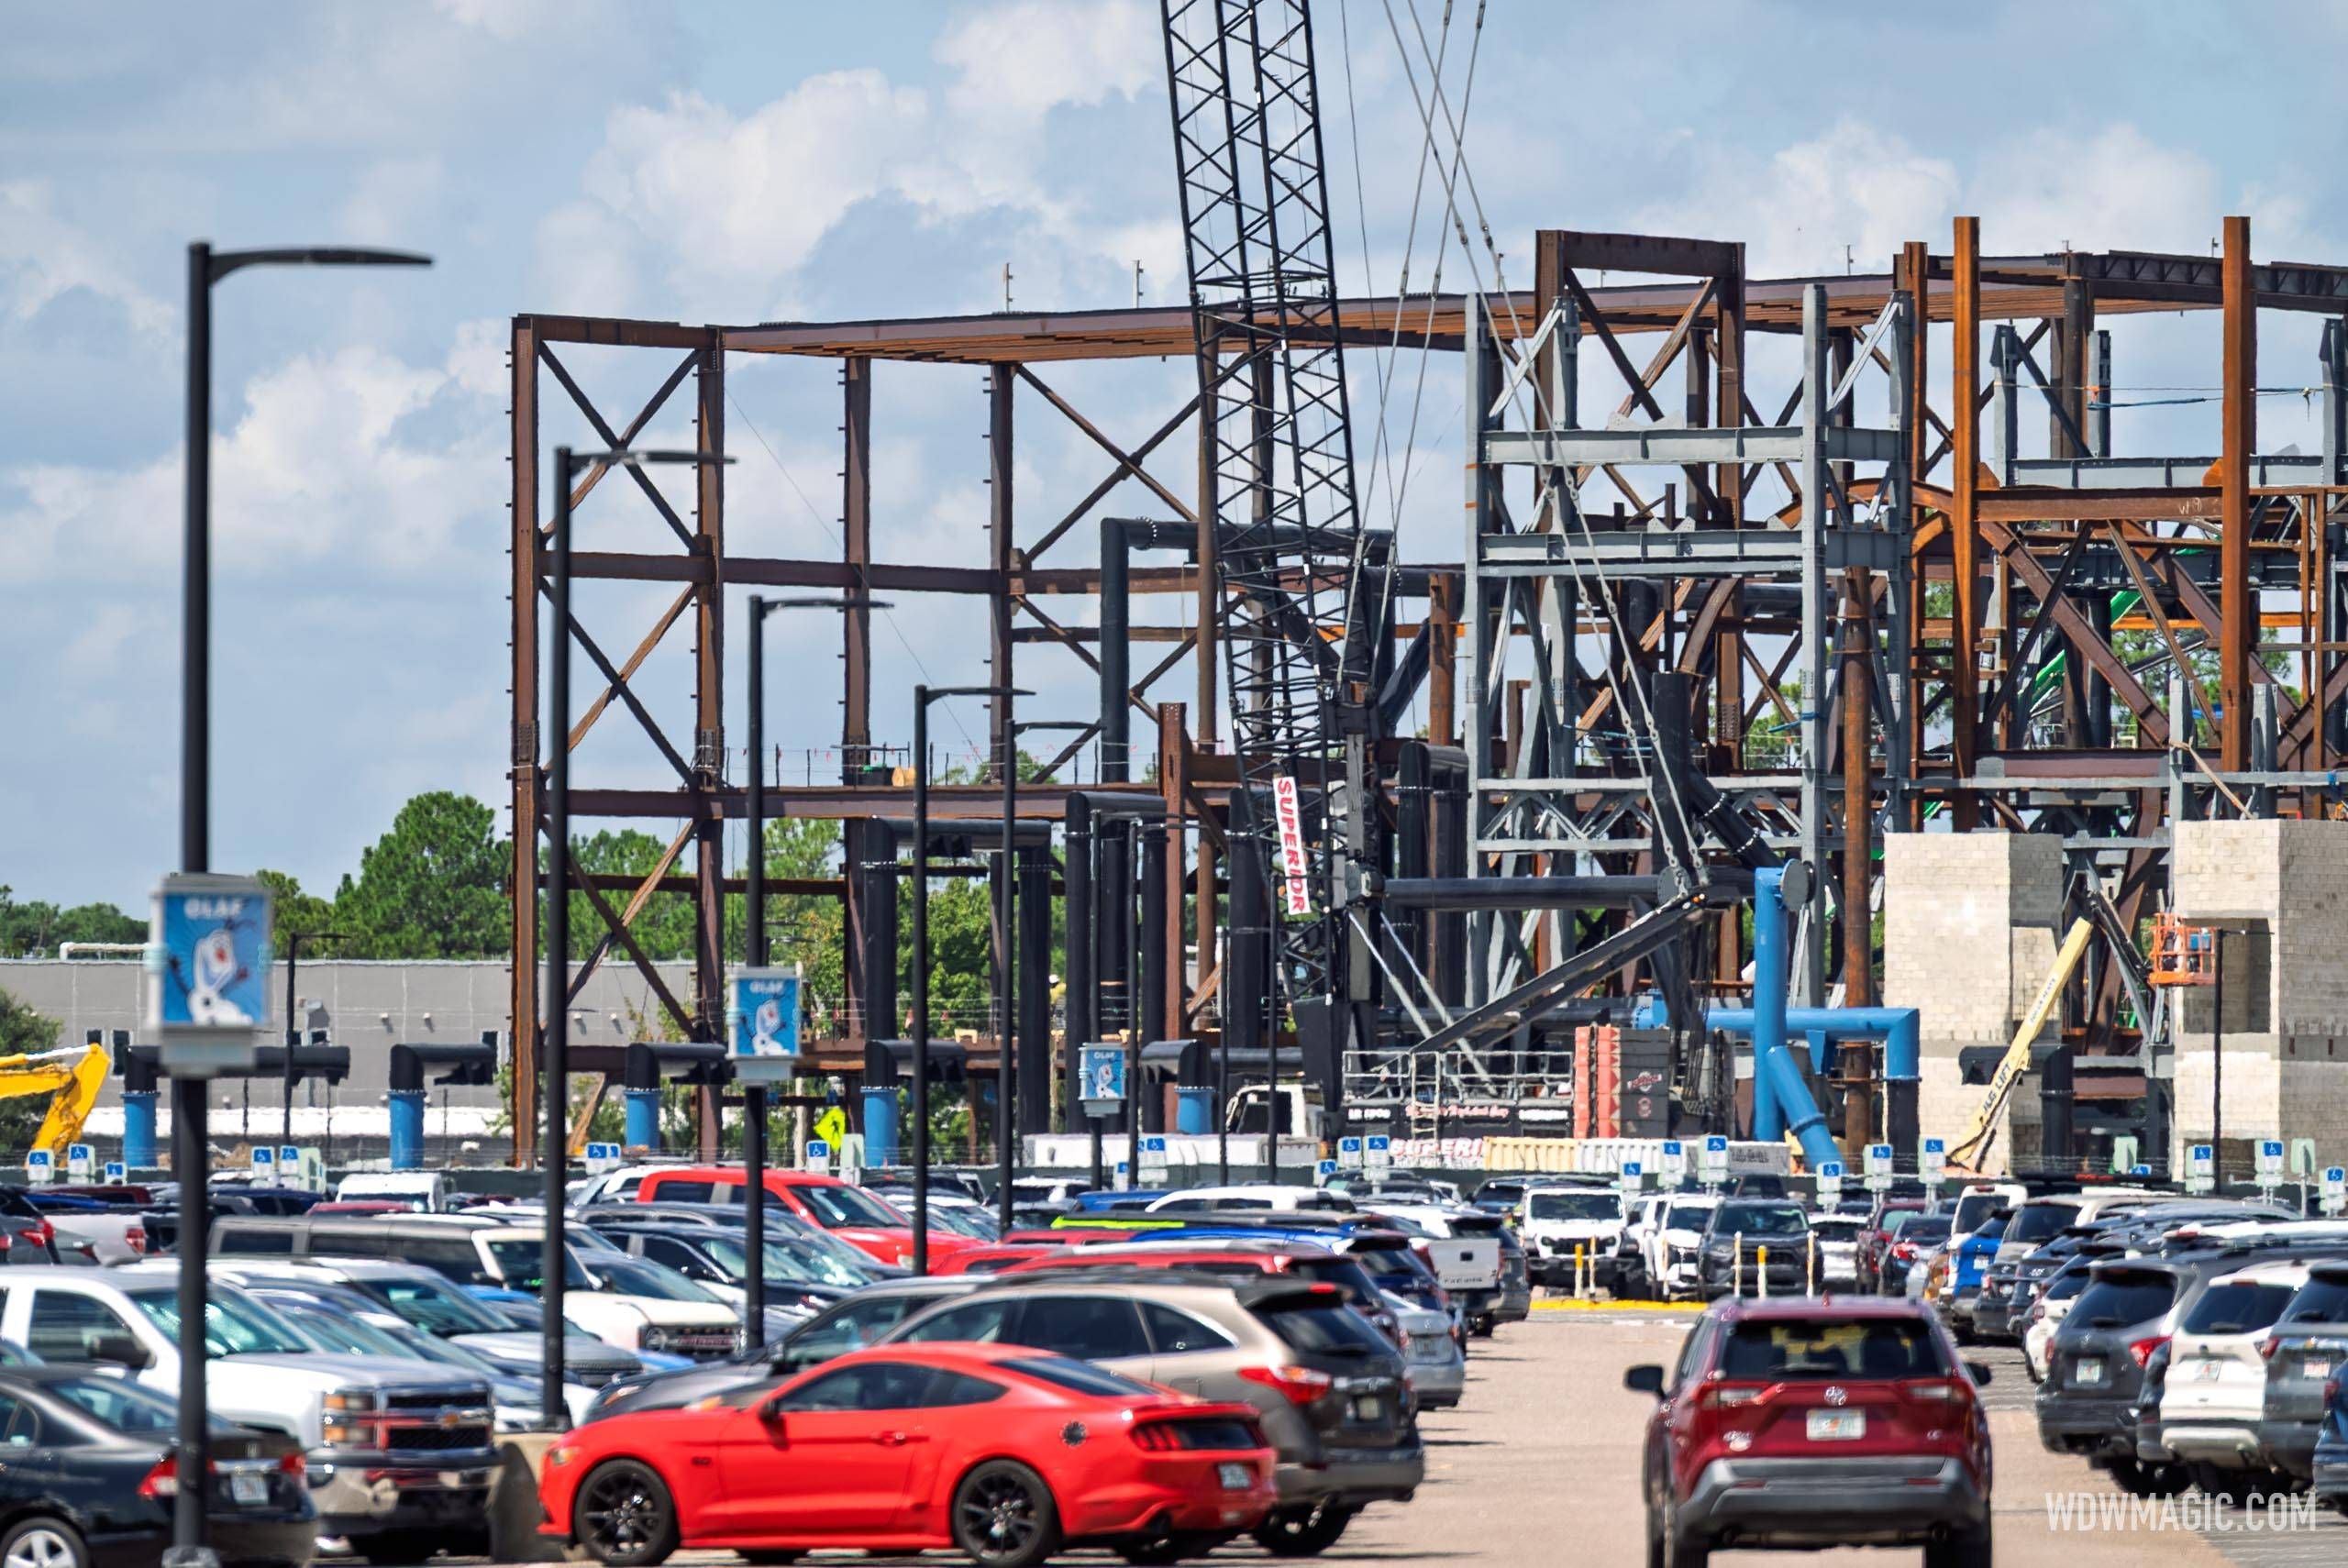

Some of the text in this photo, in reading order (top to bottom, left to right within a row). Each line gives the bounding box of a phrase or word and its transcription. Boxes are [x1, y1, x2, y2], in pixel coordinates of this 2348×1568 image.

[1277, 777, 1305, 913] SUPERIOR
[184, 898, 242, 919] OLAF
[1994, 1062, 2012, 1091] LIFT
